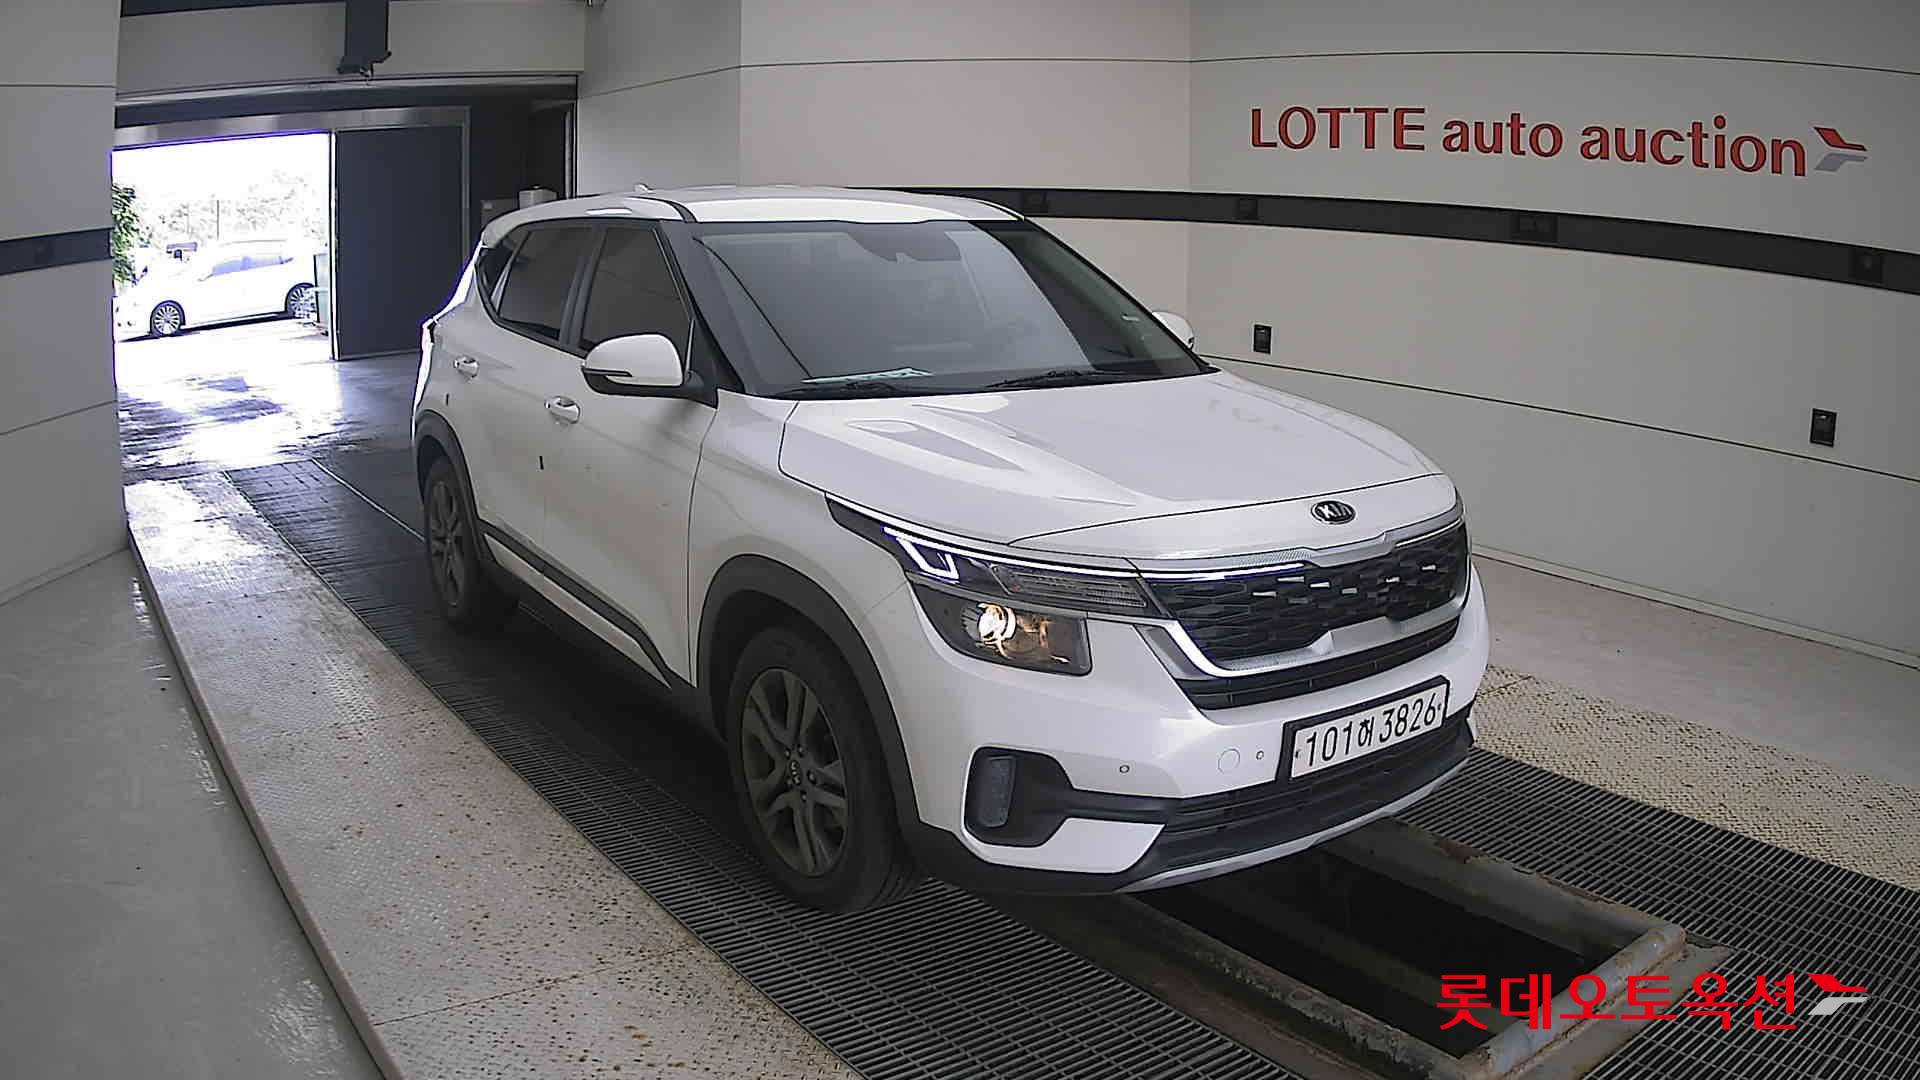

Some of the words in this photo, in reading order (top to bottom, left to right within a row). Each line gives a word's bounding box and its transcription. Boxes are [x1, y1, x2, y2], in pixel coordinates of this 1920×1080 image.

[1250, 106, 1426, 151] LOTTE
[1443, 113, 1563, 158] auto
[1580, 115, 1807, 177] auction
[1316, 502, 1352, 519] KIA
[1379, 692, 1437, 743] 3826
